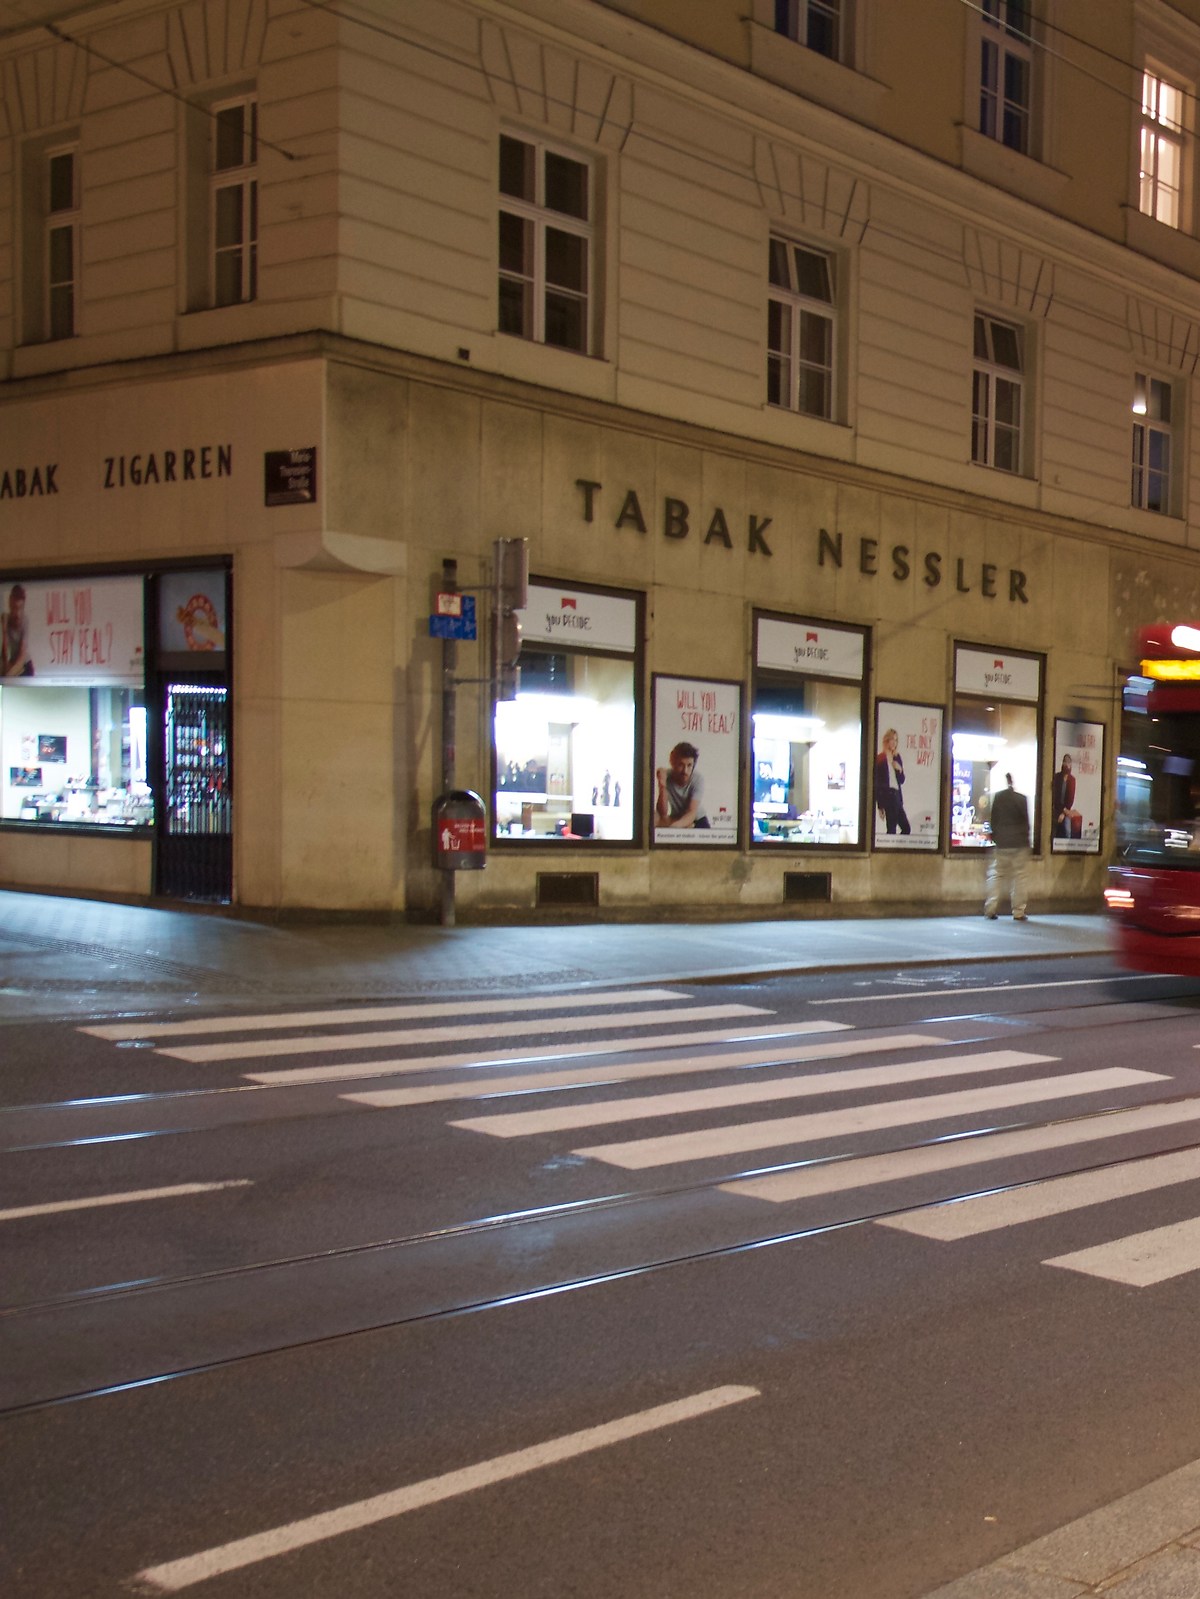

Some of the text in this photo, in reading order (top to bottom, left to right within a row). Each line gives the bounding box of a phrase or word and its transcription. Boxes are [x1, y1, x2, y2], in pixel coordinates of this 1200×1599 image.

[103, 444, 232, 489] ZIGARREN
[574, 478, 1030, 604] TABAK NESSLER
[676, 690, 697, 710] WILL
[681, 711, 704, 732] STAY
